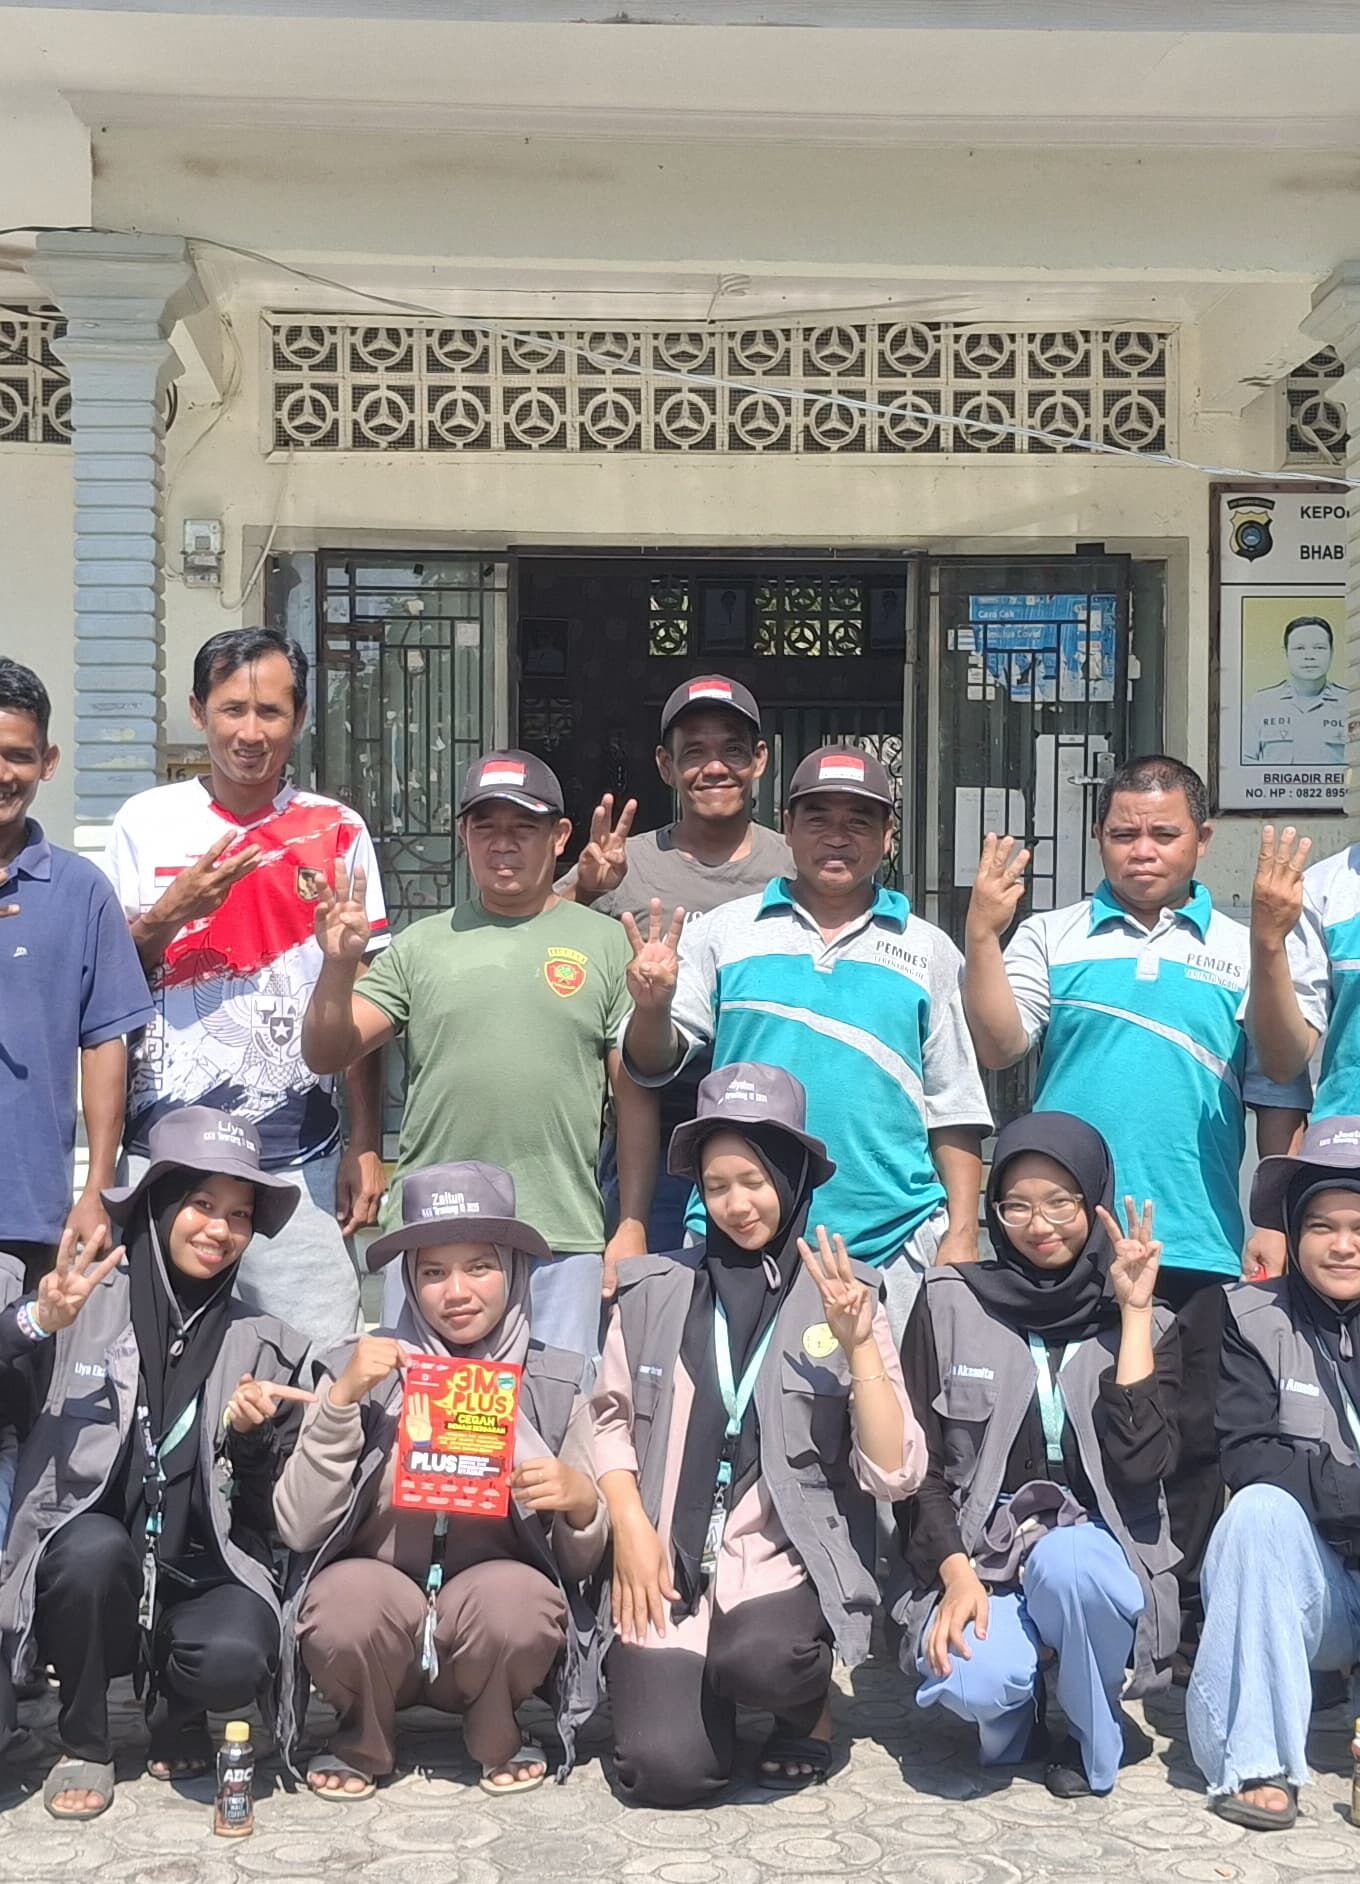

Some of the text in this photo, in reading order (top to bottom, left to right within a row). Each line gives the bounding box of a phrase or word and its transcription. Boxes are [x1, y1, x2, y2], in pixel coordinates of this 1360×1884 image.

[1300, 545, 1347, 560] BHAB
[1263, 773, 1321, 784] BRIGADIR
[1245, 788, 1267, 799] NO.
[1269, 788, 1286, 799] HP
[1296, 788, 1322, 799] 0822
[1325, 788, 1350, 799] 895
[876, 940, 928, 969] PEMDES
[1187, 953, 1242, 978] PEMDES
[452, 1390, 507, 1414] PLUS
[411, 1451, 457, 1473] PLUS
[224, 1768, 254, 1782] ABC
